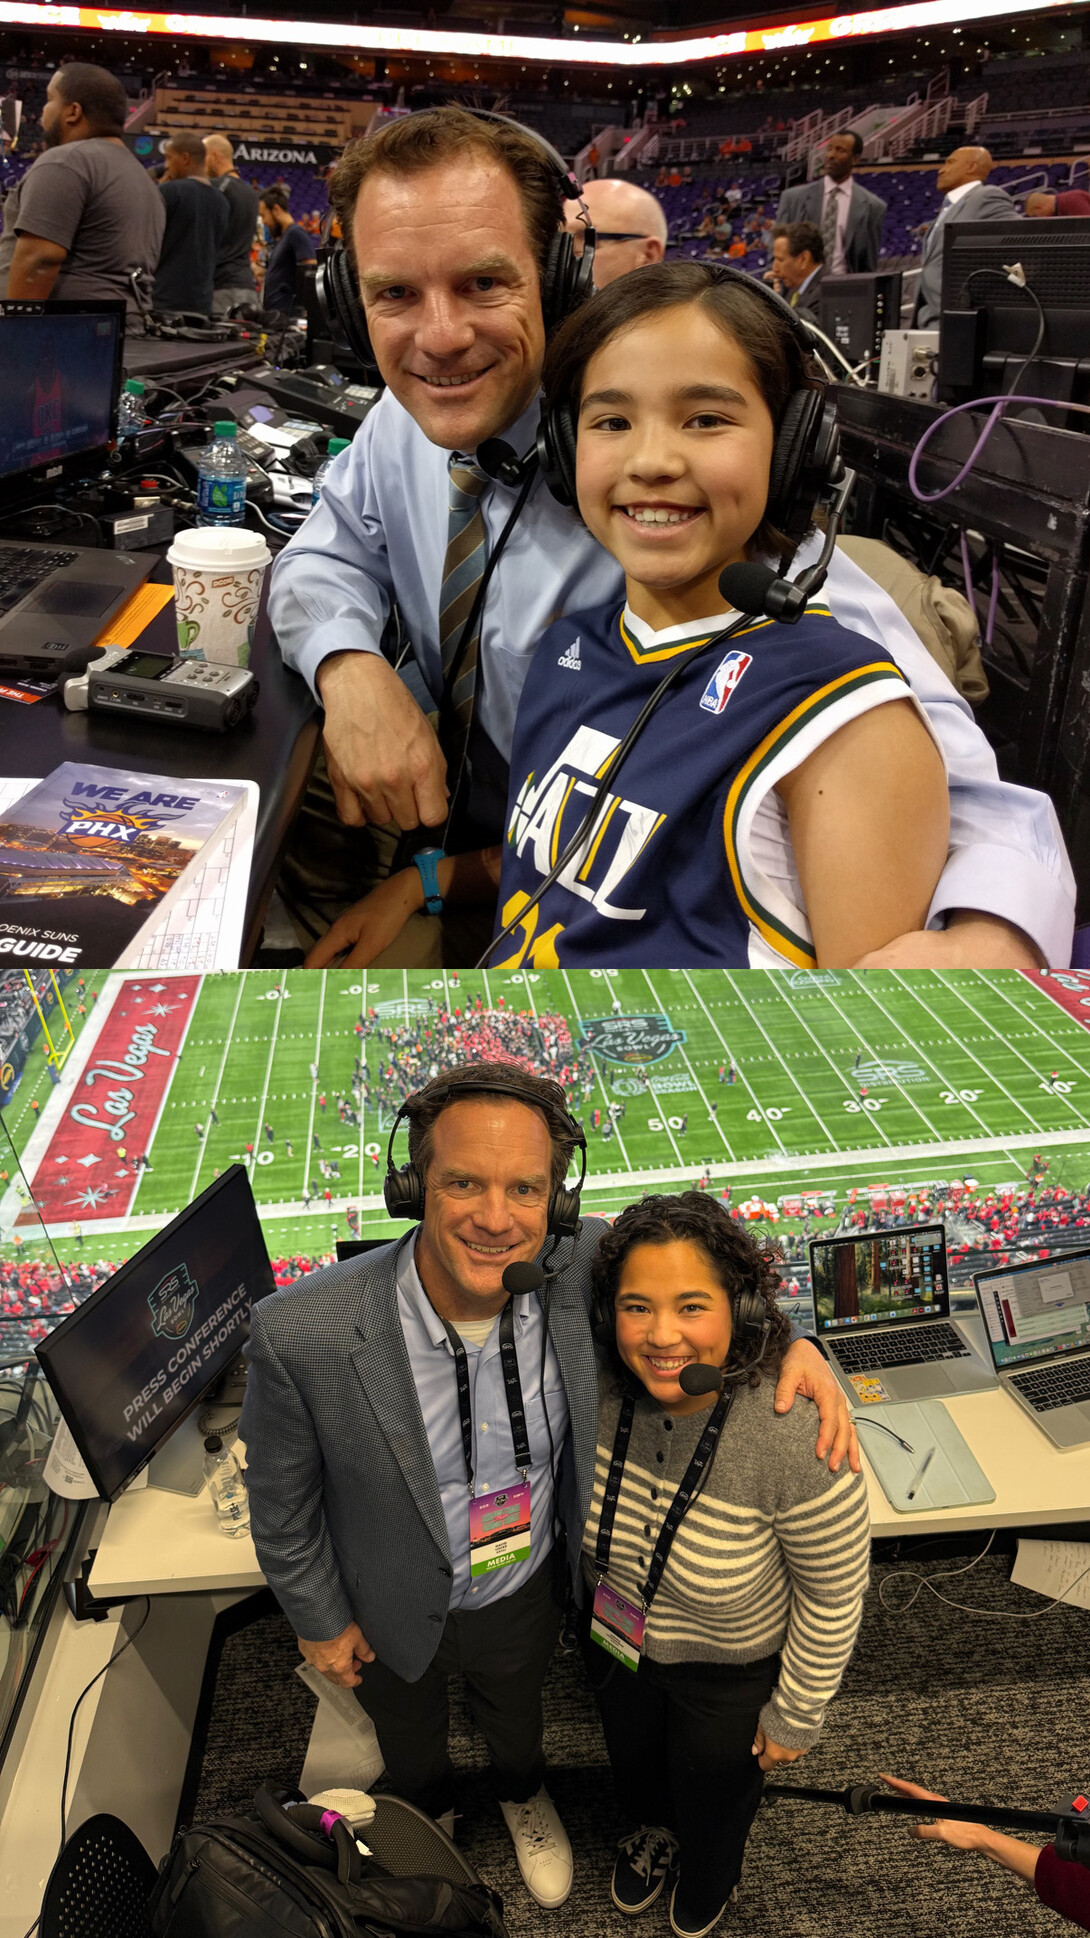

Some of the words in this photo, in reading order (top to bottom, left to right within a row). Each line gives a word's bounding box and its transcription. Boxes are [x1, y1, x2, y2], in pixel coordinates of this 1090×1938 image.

[234, 143, 317, 164] ARIZONA
[558, 656, 582, 671] adidas
[701, 693, 719, 710] NBA
[71, 781, 129, 801] WE
[126, 791, 201, 811] ARE
[65, 821, 137, 841] PHX
[0, 923, 41, 937] OENIX
[41, 930, 80, 943] SUNS
[0, 937, 83, 964] GUIDE
[349, 984, 381, 994] 20
[601, 1018, 649, 1030] SRS
[590, 1033, 624, 1048] Las
[622, 1031, 681, 1048] Vegas
[85, 1023, 172, 1086] Vegas
[850, 1064, 927, 1083] SRS
[1038, 1080, 1072, 1095] 10
[939, 1088, 979, 1105] 20
[842, 1098, 882, 1113] 30
[70, 1088, 136, 1141] Las
[746, 1107, 784, 1123] 40
[648, 1116, 684, 1132] 50
[241, 1151, 275, 1167] 10
[342, 1142, 382, 1159] 20
[158, 1275, 180, 1301] SRS
[156, 1305, 173, 1331] Las
[169, 1285, 196, 1313] Vegas
[170, 1309, 186, 1325] BOWL
[122, 1369, 168, 1423] PRESS
[166, 1282, 248, 1374] CONFERENCE
[126, 1401, 164, 1443] WILL
[162, 1355, 203, 1407] BEGIN
[202, 1296, 253, 1362] SHORTLY
[487, 1553, 516, 1567] MEDIA
[602, 1639, 626, 1661] MEDIA
